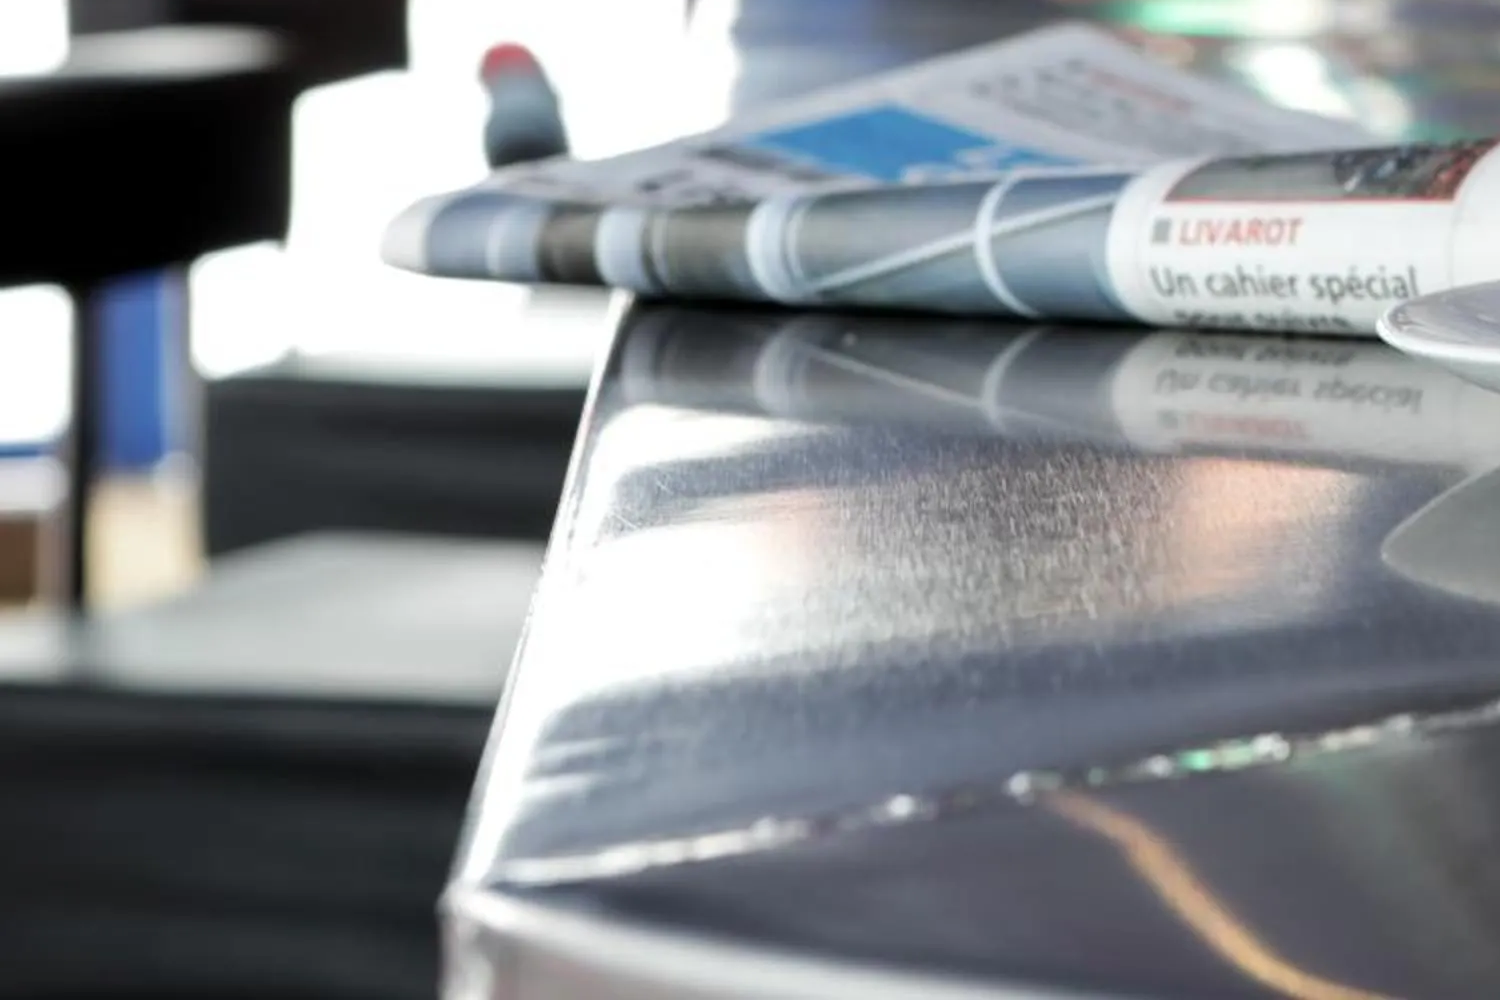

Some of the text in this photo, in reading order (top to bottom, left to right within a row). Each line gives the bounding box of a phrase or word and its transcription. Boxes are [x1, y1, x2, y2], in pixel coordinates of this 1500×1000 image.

[1179, 217, 1303, 246] LIVAROT
[1150, 264, 1419, 303] Un cahier spécial
